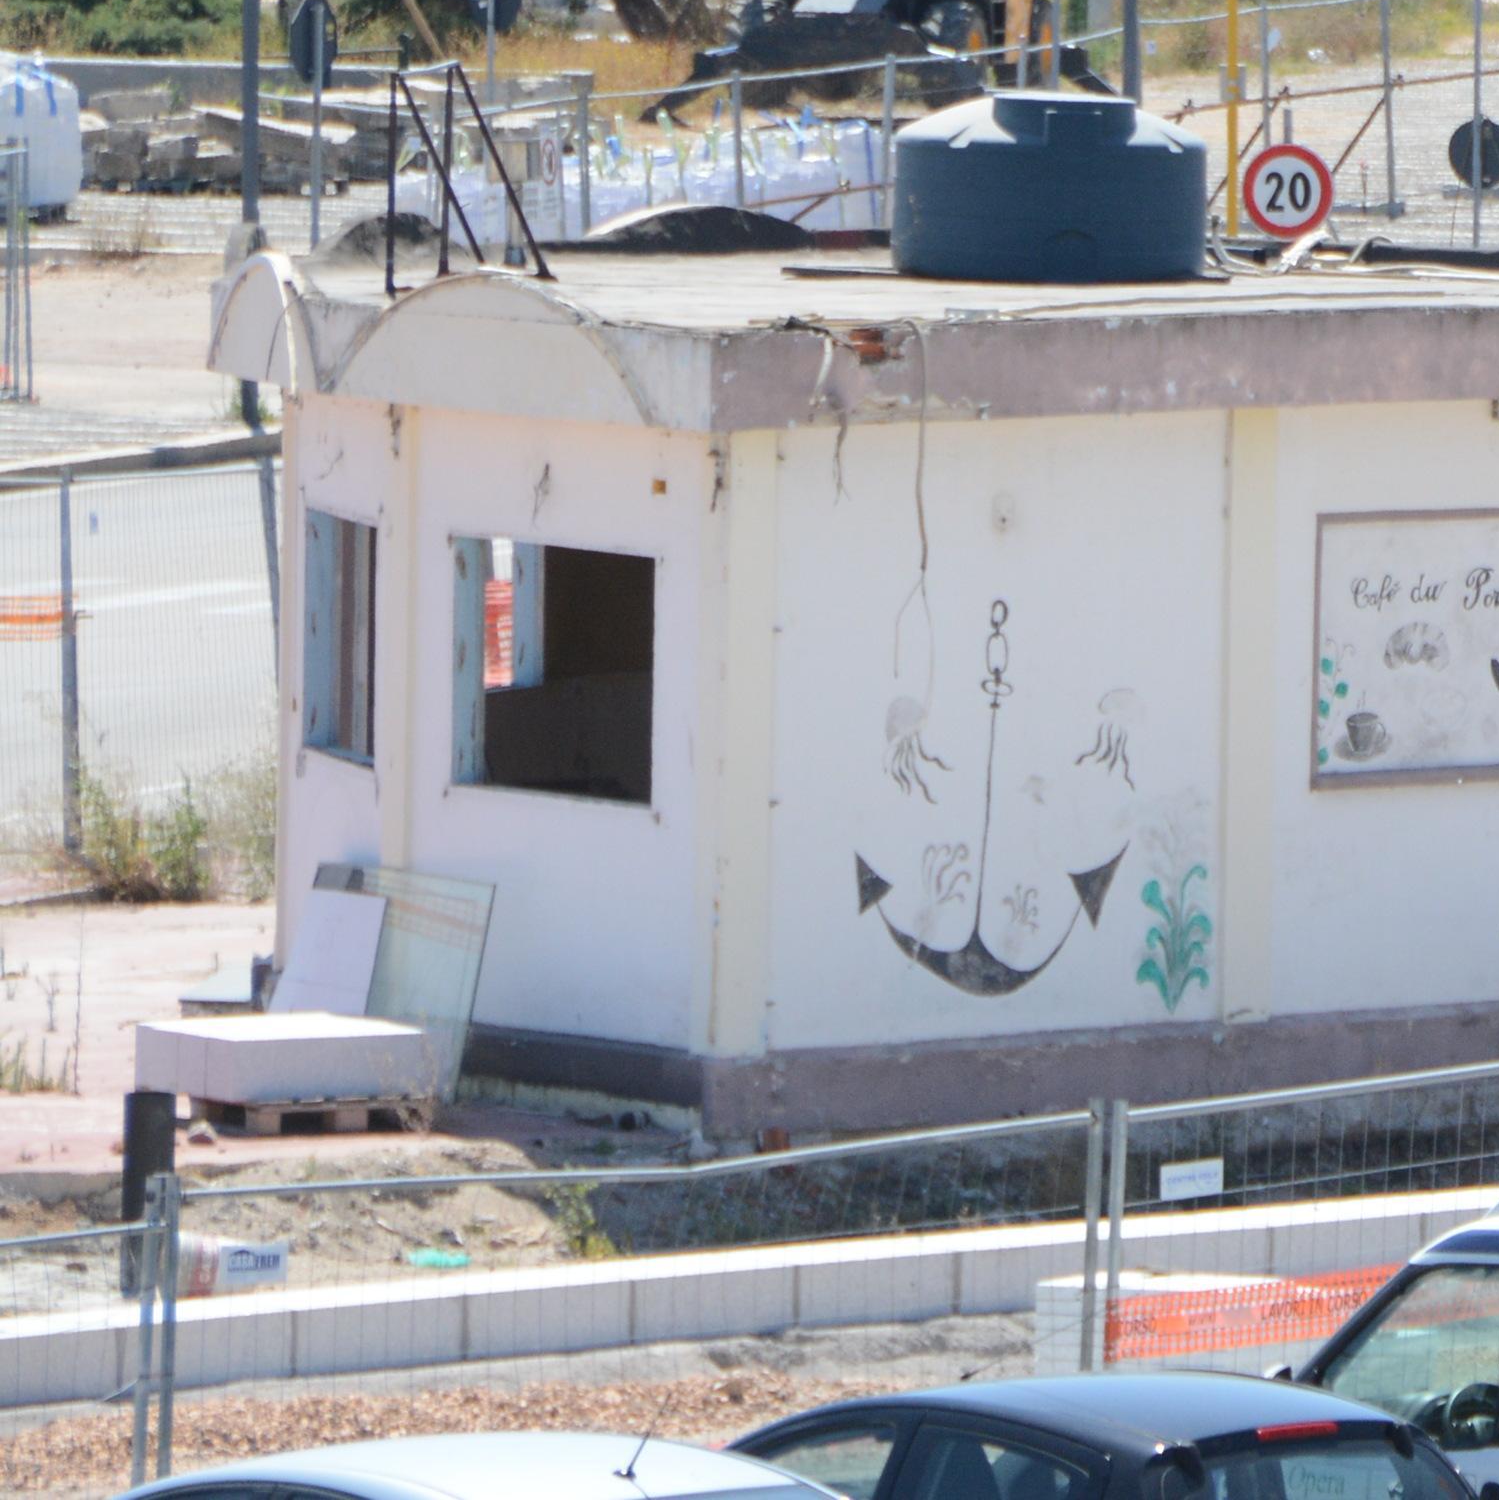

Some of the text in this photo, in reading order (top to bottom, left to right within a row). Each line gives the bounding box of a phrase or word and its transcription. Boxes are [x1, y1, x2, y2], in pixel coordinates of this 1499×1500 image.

[1264, 171, 1312, 213] 20
[1410, 573, 1447, 603] du
[1261, 1295, 1307, 1321] LAVORI
[1327, 1291, 1367, 1311] CORSO
